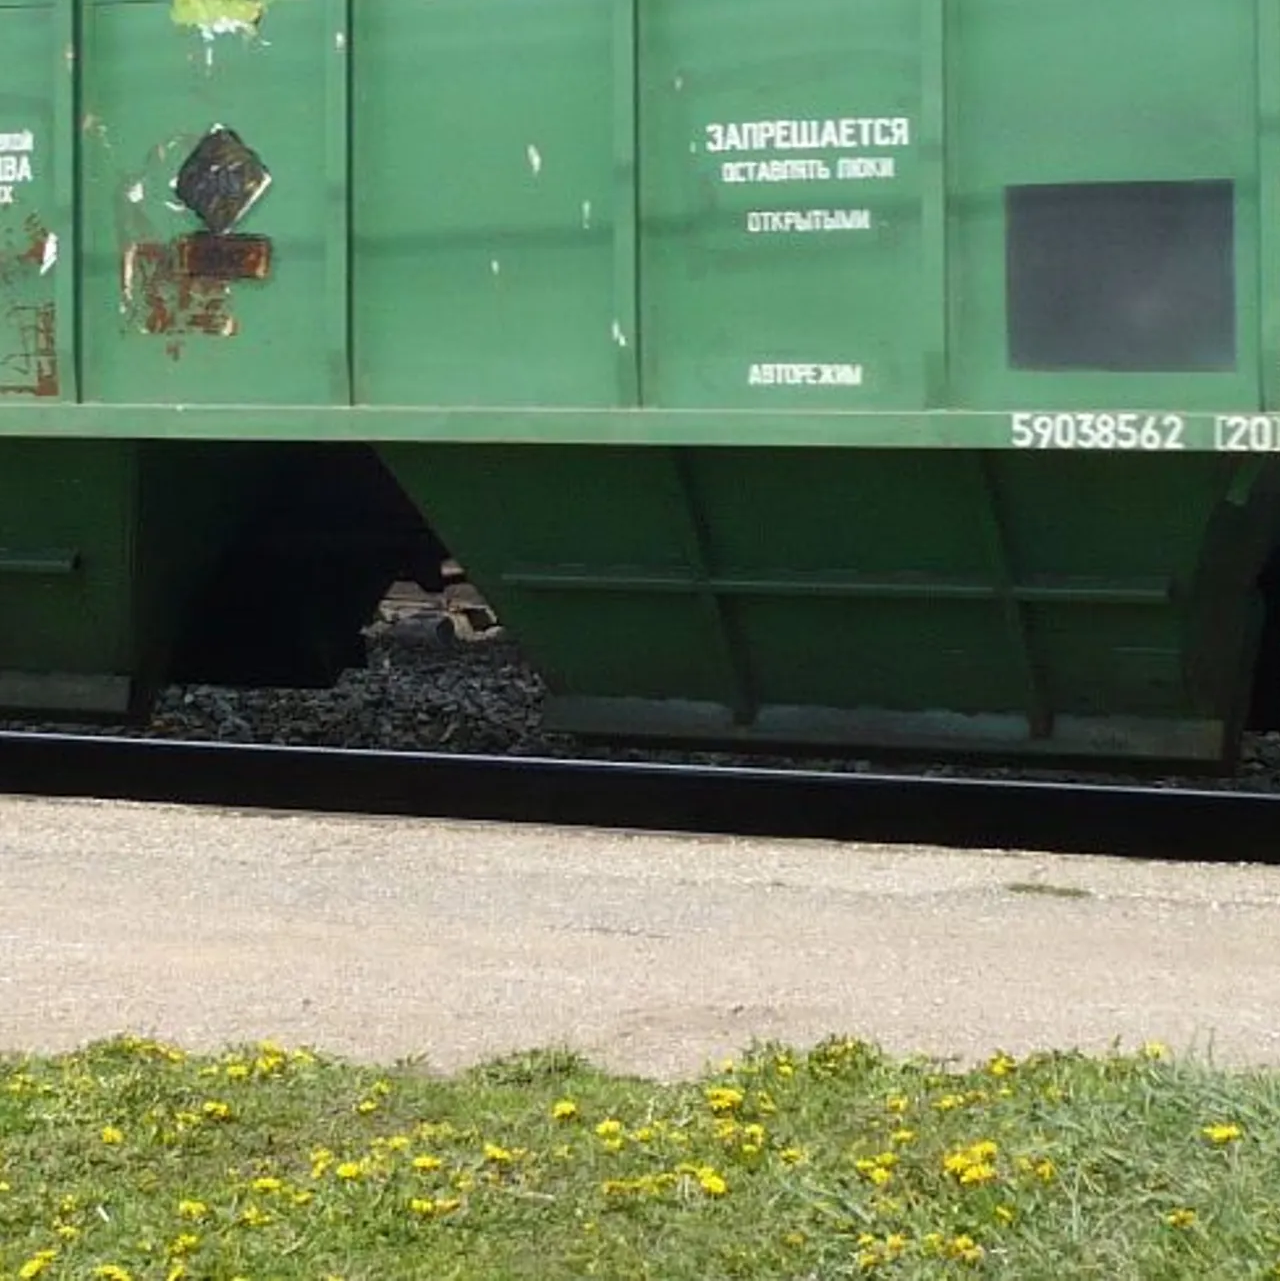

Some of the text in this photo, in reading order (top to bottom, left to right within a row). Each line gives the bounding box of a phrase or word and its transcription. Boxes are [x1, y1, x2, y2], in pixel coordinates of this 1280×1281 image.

[705, 117, 910, 152] ЗАПРЕЩАЕТСЯ
[747, 209, 872, 232] ОТКРЫТЫМИ
[748, 364, 863, 386] АВТОРЕЖИМ
[1011, 414, 1184, 449] 59038562
